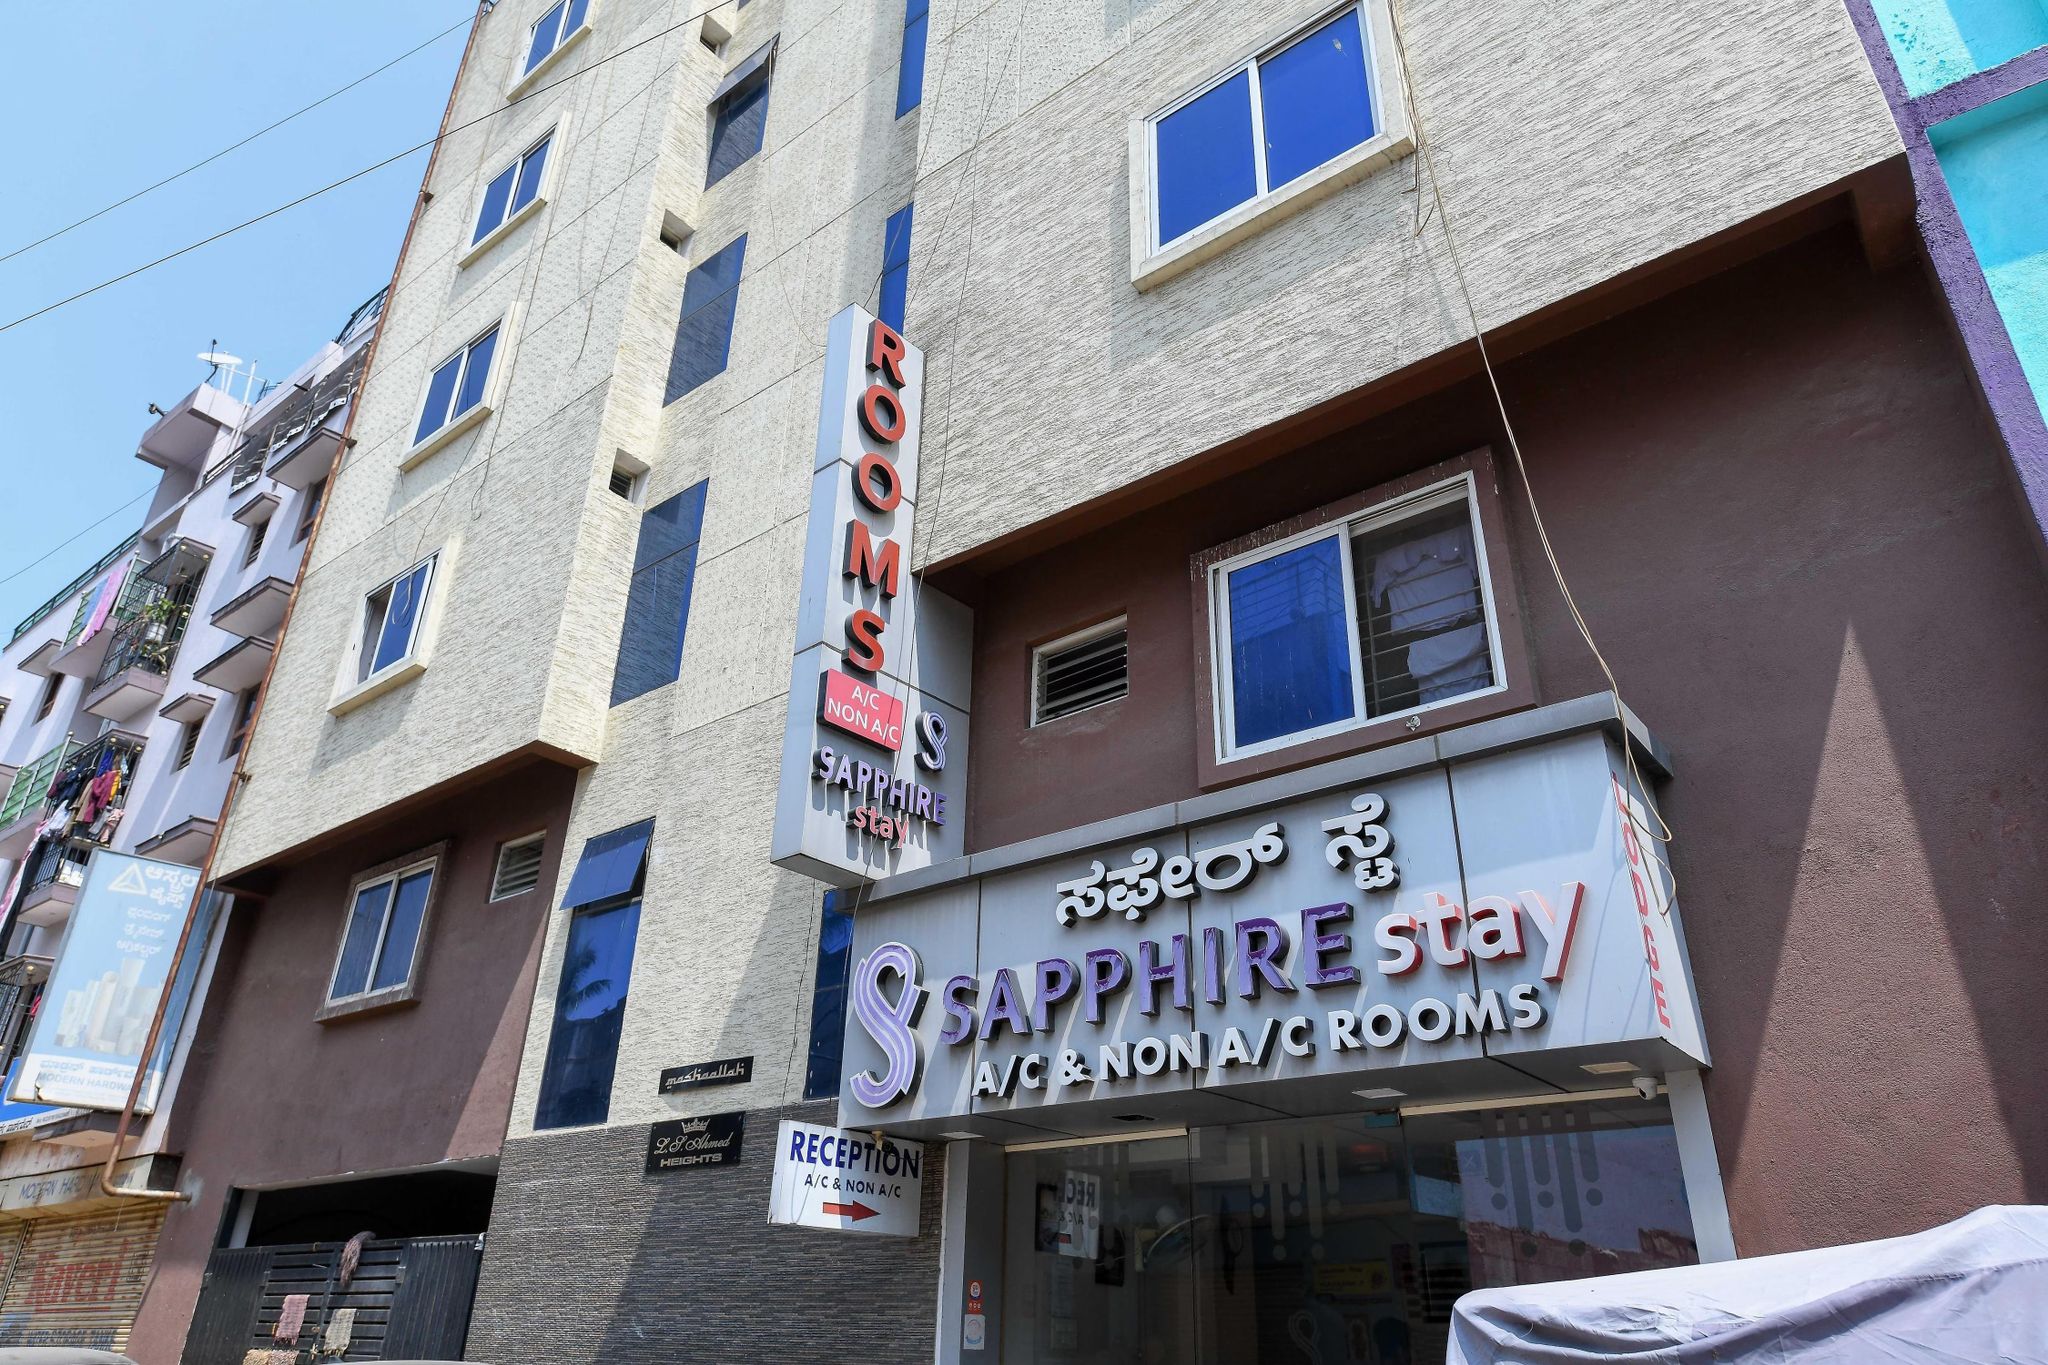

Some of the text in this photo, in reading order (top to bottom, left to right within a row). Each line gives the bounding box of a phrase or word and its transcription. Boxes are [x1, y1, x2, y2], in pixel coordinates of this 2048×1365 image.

[841, 318, 906, 674] ROOMS
[827, 696, 900, 746] NON A/C
[851, 685, 880, 712] A/C
[813, 744, 948, 827] SAPPHIRE
[848, 802, 911, 849] stay
[941, 881, 1585, 1047] SAPPHIRE stay
[972, 984, 1547, 1098] A/C & NON A/C ROOMS
[39, 1071, 85, 1086] MODERN
[660, 1153, 723, 1168] HEIGHTS
[789, 1130, 920, 1179] RECEPTION
[804, 1173, 902, 1199] A/C & NON A/C
